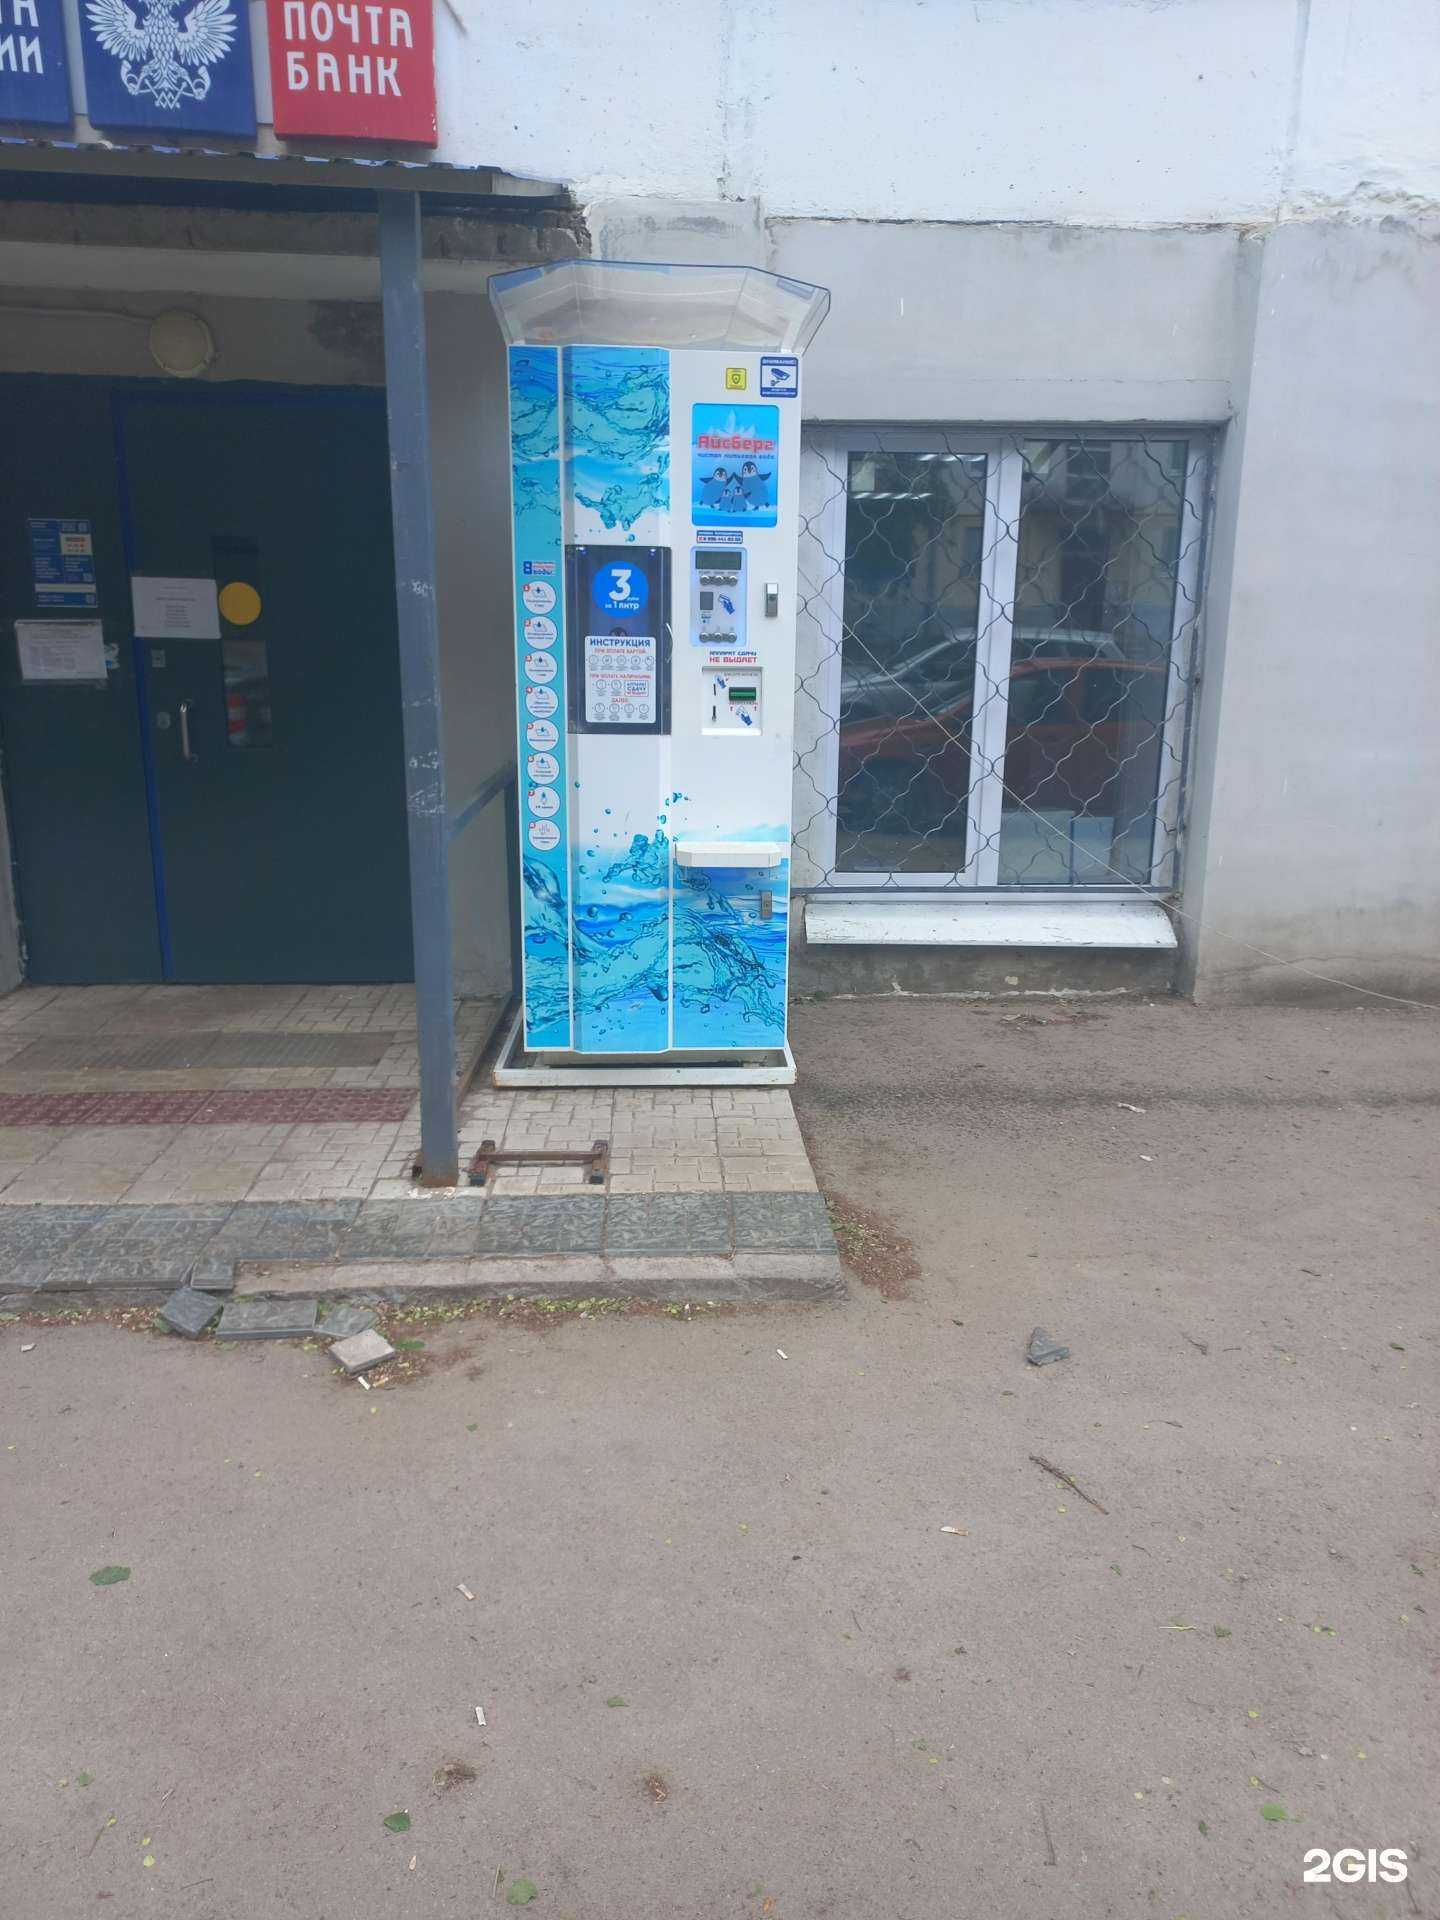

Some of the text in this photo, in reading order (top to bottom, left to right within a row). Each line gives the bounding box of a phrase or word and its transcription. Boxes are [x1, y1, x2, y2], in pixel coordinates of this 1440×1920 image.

[283, 1, 412, 48] ПОЧТА
[286, 50, 401, 97] БАНК
[608, 568, 632, 601] 3
[590, 638, 651, 648] ИНСТРУКЦИЯ
